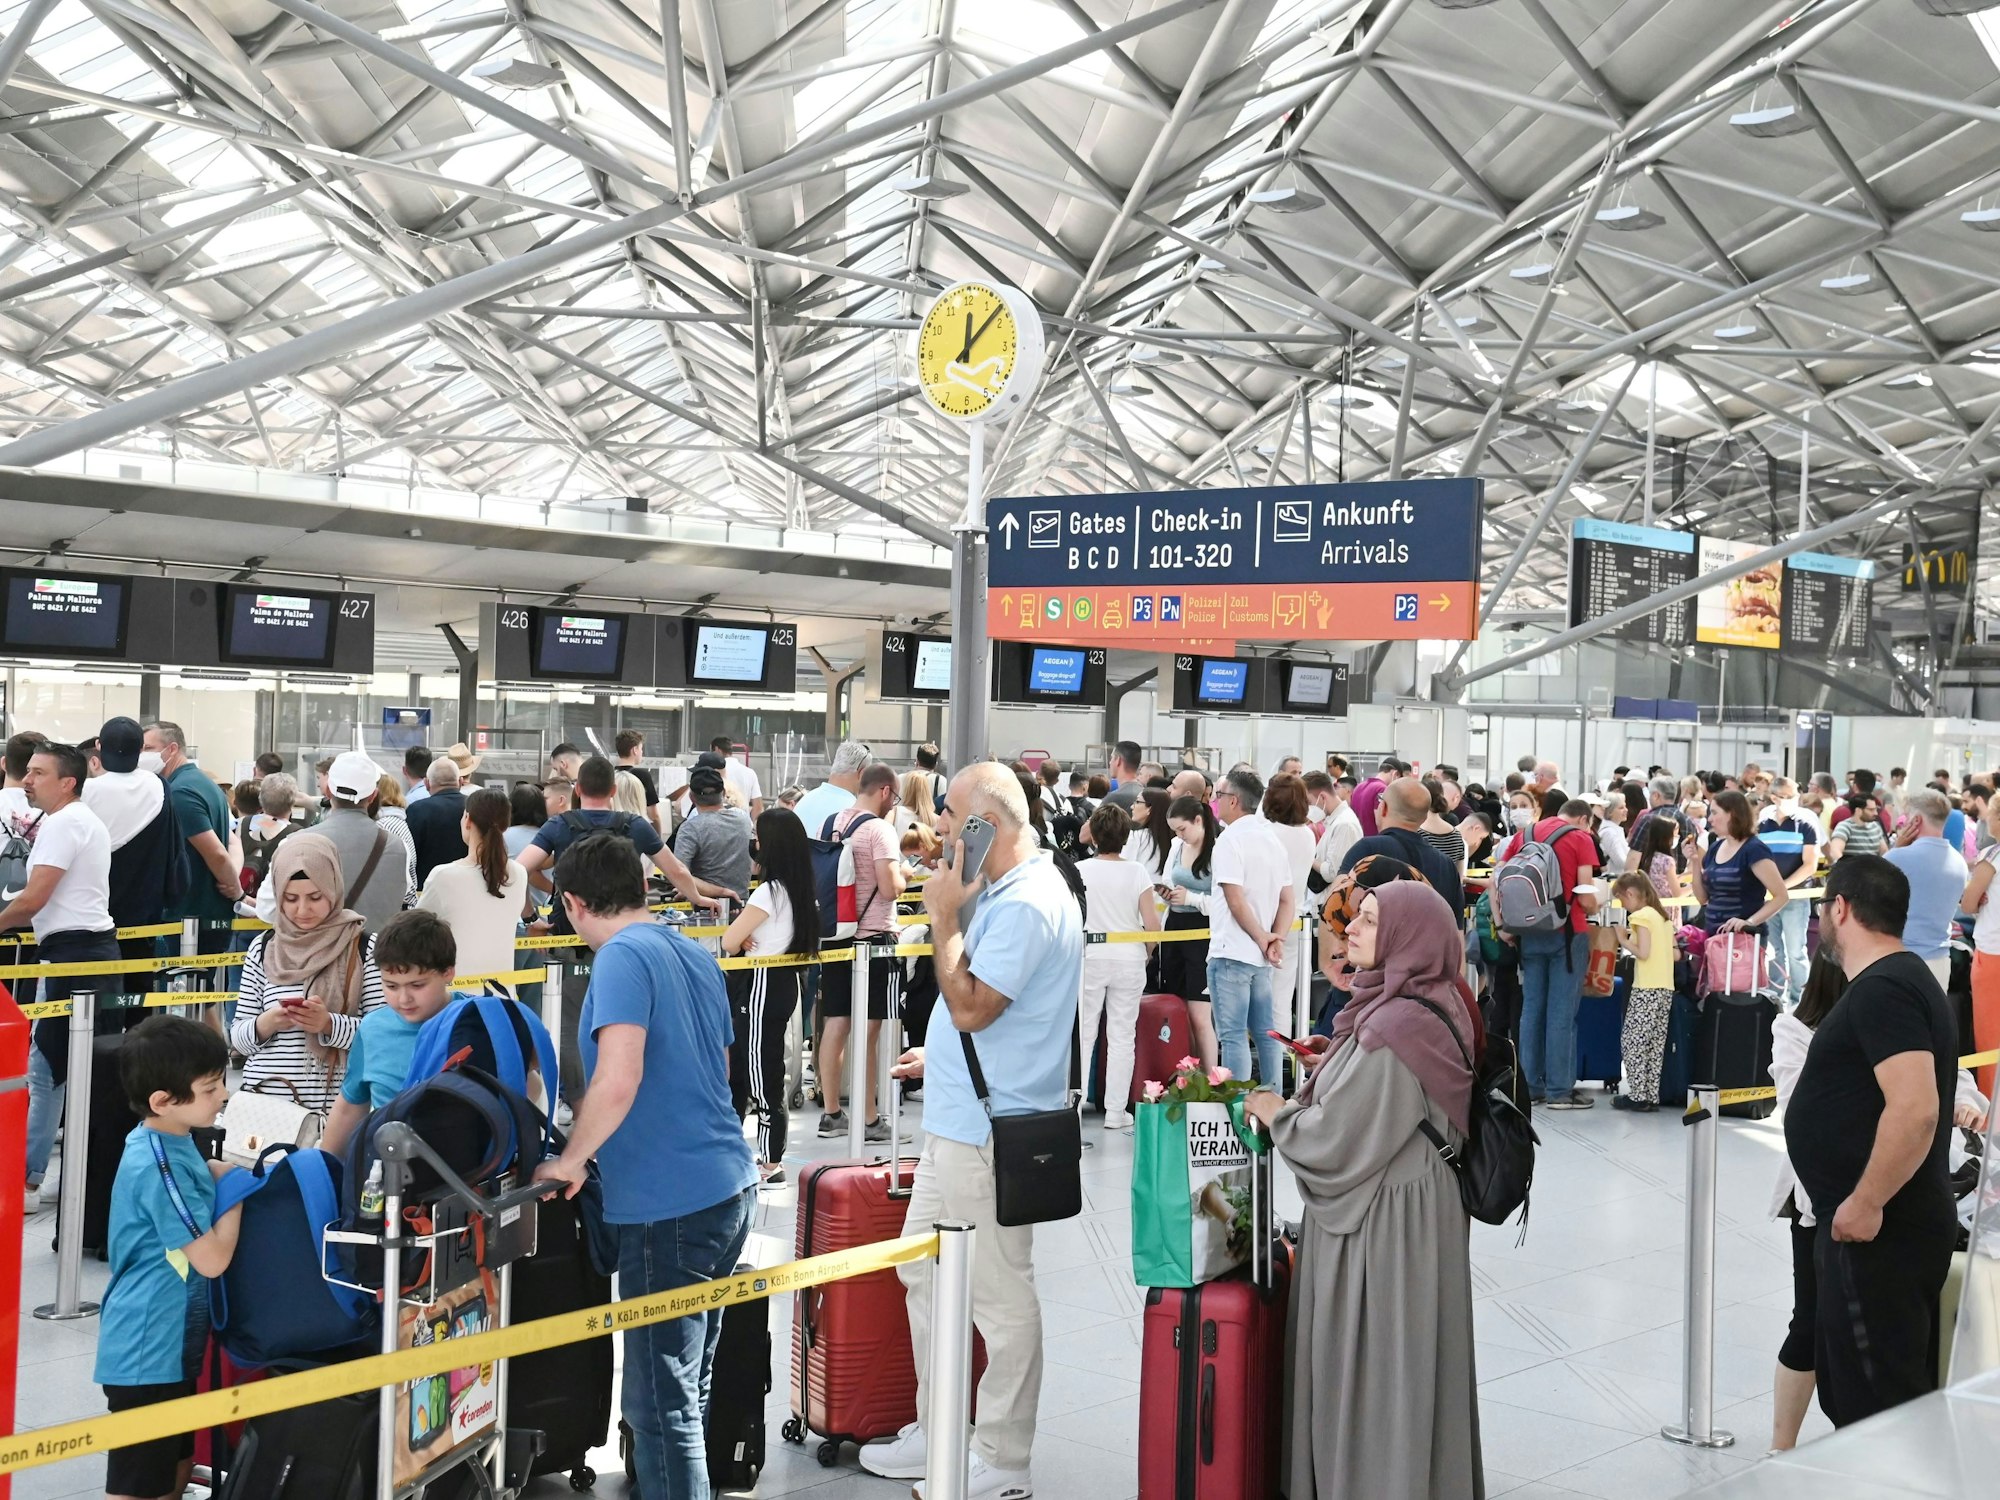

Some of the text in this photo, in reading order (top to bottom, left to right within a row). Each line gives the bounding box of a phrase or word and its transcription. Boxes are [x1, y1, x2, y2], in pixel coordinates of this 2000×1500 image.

[964, 296, 974, 306] 12
[984, 301, 989, 312] 1
[946, 306, 956, 316] 11
[997, 318, 1002, 328] 2
[932, 326, 942, 336] 10
[1002, 341, 1008, 352] 3
[928, 350, 934, 360] 9
[995, 365, 1000, 376] 4
[934, 374, 938, 382] 8
[946, 392, 950, 402] 7
[984, 388, 988, 398] 5
[964, 396, 970, 406] 6
[1323, 499, 1414, 526] Ankunft
[1070, 512, 1126, 534] Gates
[1151, 507, 1242, 532] Check-in
[1149, 544, 1232, 568] 101-320
[1321, 538, 1409, 564] Arrivals
[1704, 549, 1724, 560] Wieder
[1068, 546, 1119, 570] B C D
[28, 592, 52, 602] Palma
[68, 595, 102, 604] Mallorca
[1188, 597, 1222, 608] Polizei
[1230, 596, 1249, 607] Zoll
[250, 608, 272, 616] Palma
[284, 610, 314, 618] Mallorca
[340, 600, 370, 618] 427
[1047, 598, 1060, 620] S
[1134, 598, 1152, 620] P3
[1396, 596, 1417, 619] P2
[502, 610, 528, 629] 426
[1188, 612, 1216, 622] Police
[1230, 611, 1268, 622] Customs
[772, 630, 794, 646] 425
[886, 636, 906, 652] 424
[1088, 650, 1104, 665] 423
[1176, 658, 1192, 670] 422
[1038, 671, 1058, 679] Baggage
[1190, 1122, 1218, 1137] ICH
[771, 1260, 850, 1288] Köln Bonn Airport
[618, 1293, 706, 1324] Köln Bonn Airport
[1, 1432, 94, 1465] onn Airport
